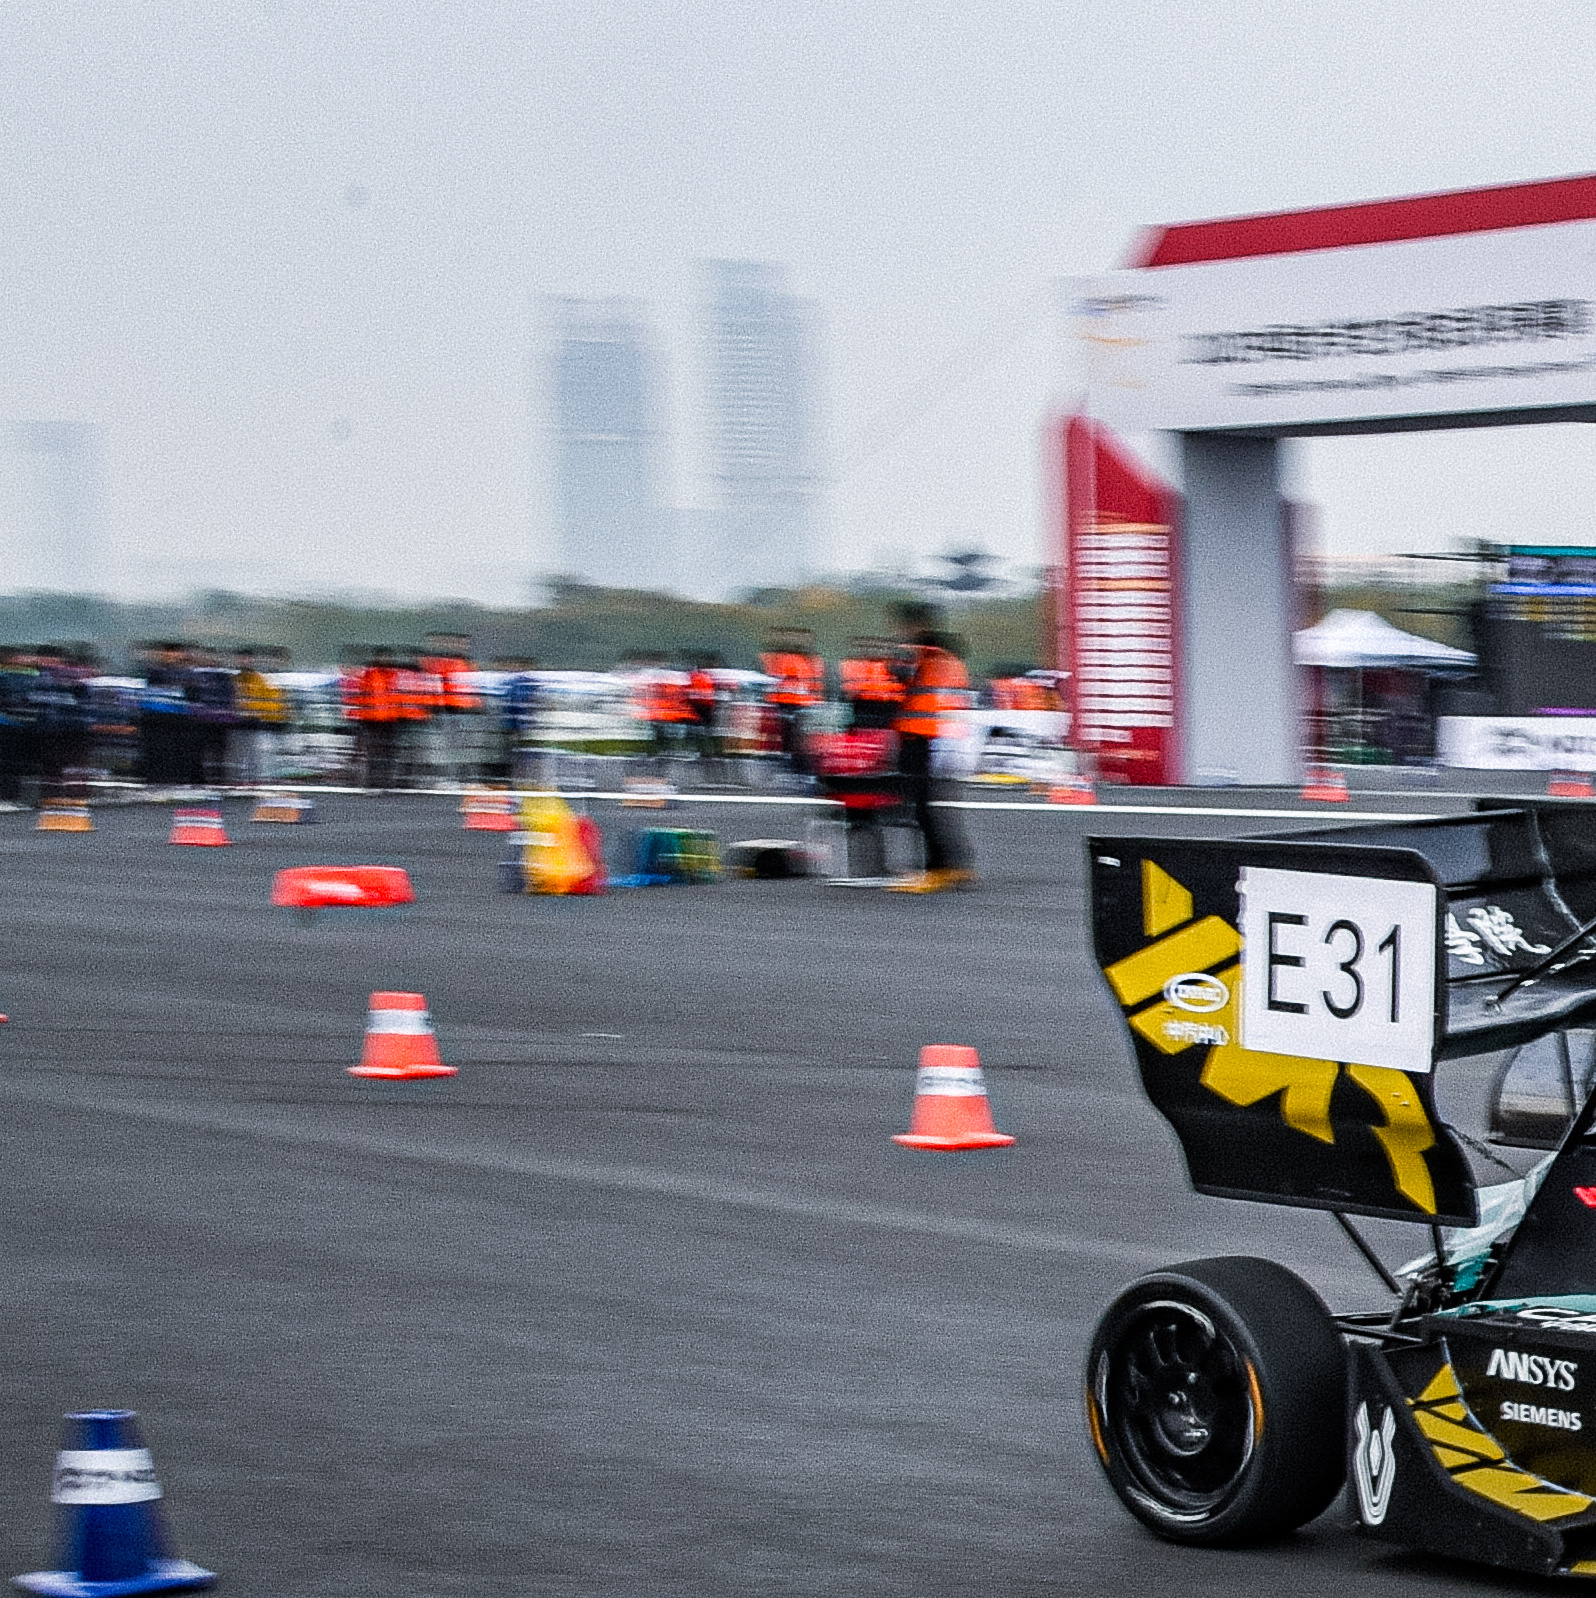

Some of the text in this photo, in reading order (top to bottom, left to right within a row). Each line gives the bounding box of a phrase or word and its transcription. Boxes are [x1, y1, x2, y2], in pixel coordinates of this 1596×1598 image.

[1265, 911, 1402, 1023] E31
[1486, 1348, 1578, 1391] ANSYS
[1500, 1401, 1582, 1431] SIEMENS
